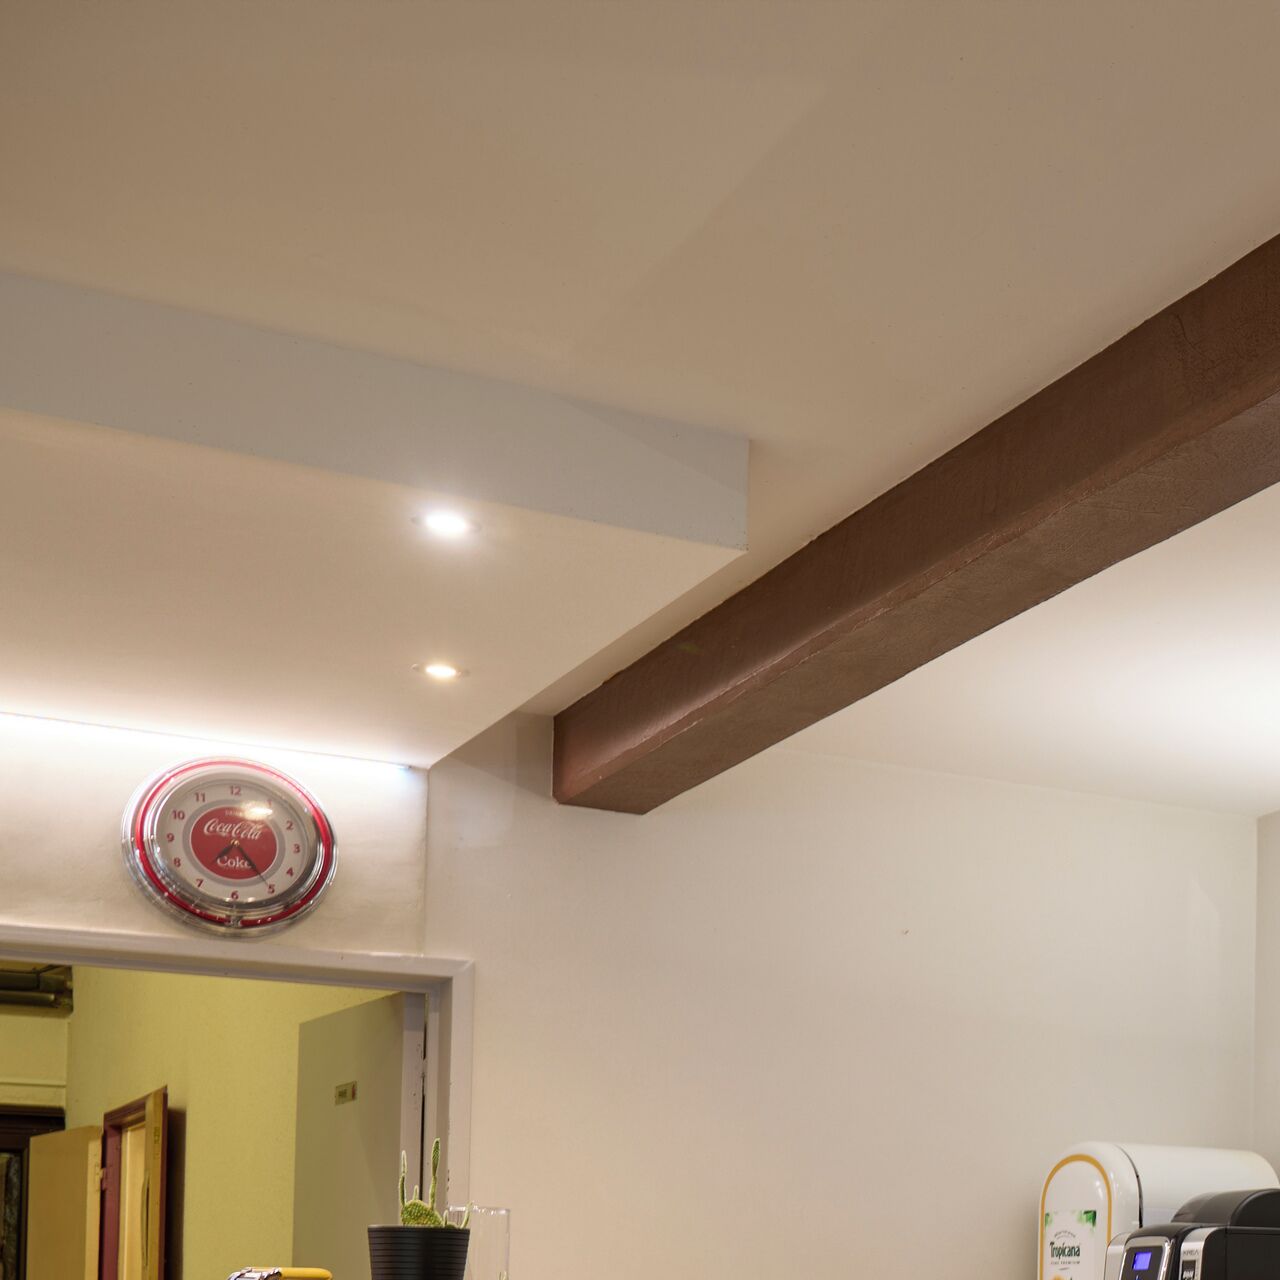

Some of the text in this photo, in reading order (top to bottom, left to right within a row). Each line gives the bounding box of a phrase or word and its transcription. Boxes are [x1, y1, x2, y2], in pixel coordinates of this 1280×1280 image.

[230, 786, 241, 795] 12
[195, 793, 205, 802] 11
[173, 810, 185, 820] 10
[286, 821, 294, 829] 2
[166, 834, 174, 842] 9
[294, 844, 300, 853] 3
[174, 858, 181, 867] 8
[216, 855, 252, 868] Coke
[286, 868, 294, 877] 4
[196, 879, 204, 887] 7
[268, 885, 275, 894] 5
[231, 890, 238, 899] 6
[1050, 1242, 1080, 1260] Tropicana
